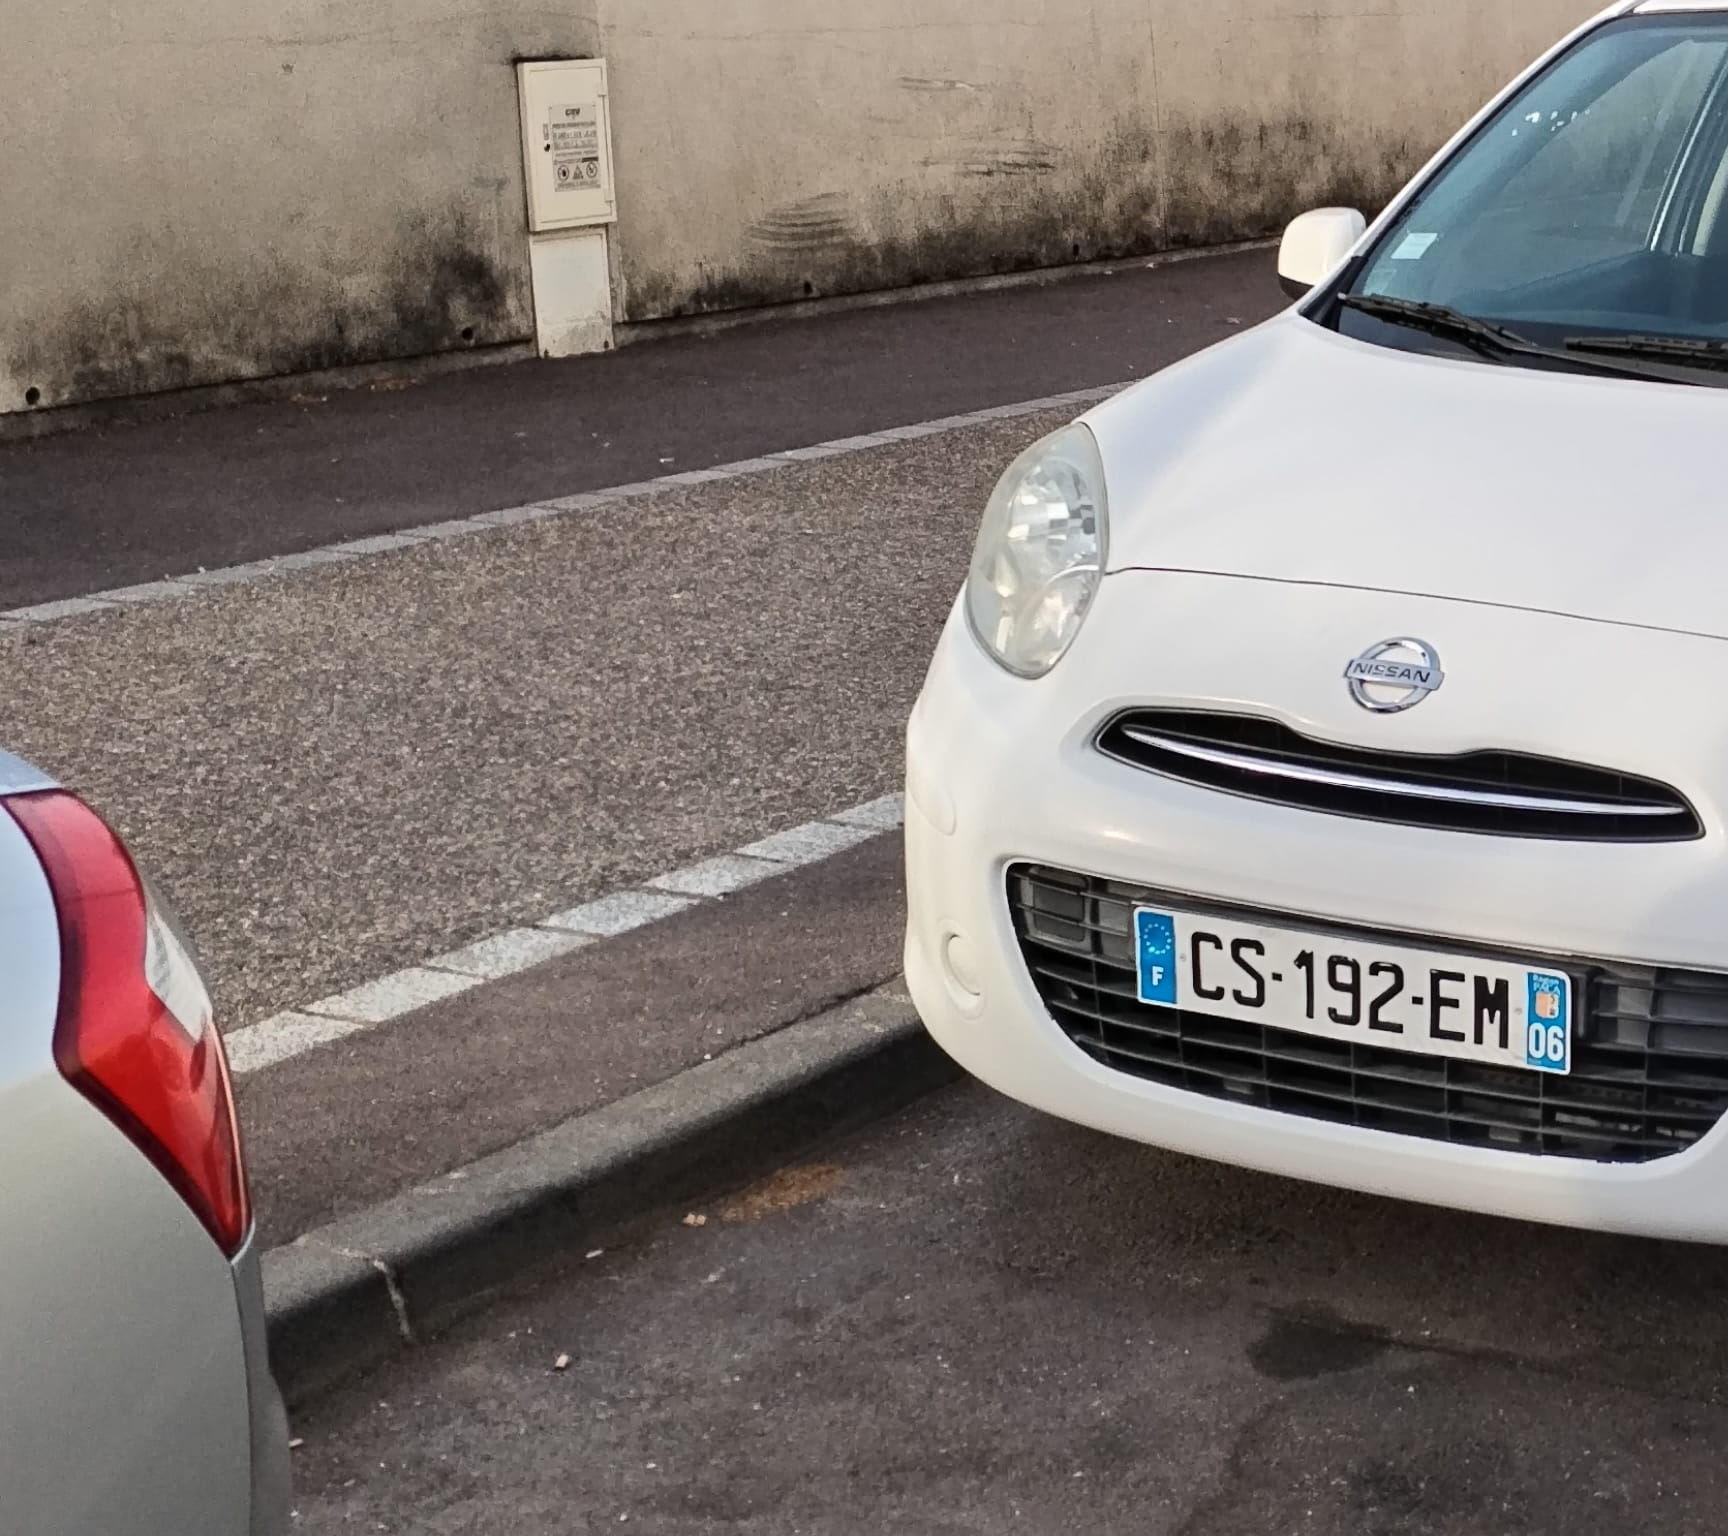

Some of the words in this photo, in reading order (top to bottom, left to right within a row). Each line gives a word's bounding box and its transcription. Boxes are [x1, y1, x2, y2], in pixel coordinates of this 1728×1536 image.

[1353, 662, 1430, 683] NISSAN
[1151, 966, 1164, 986] F
[1191, 932, 1508, 1049] CS-192-EM
[1529, 1022, 1564, 1061] 06
